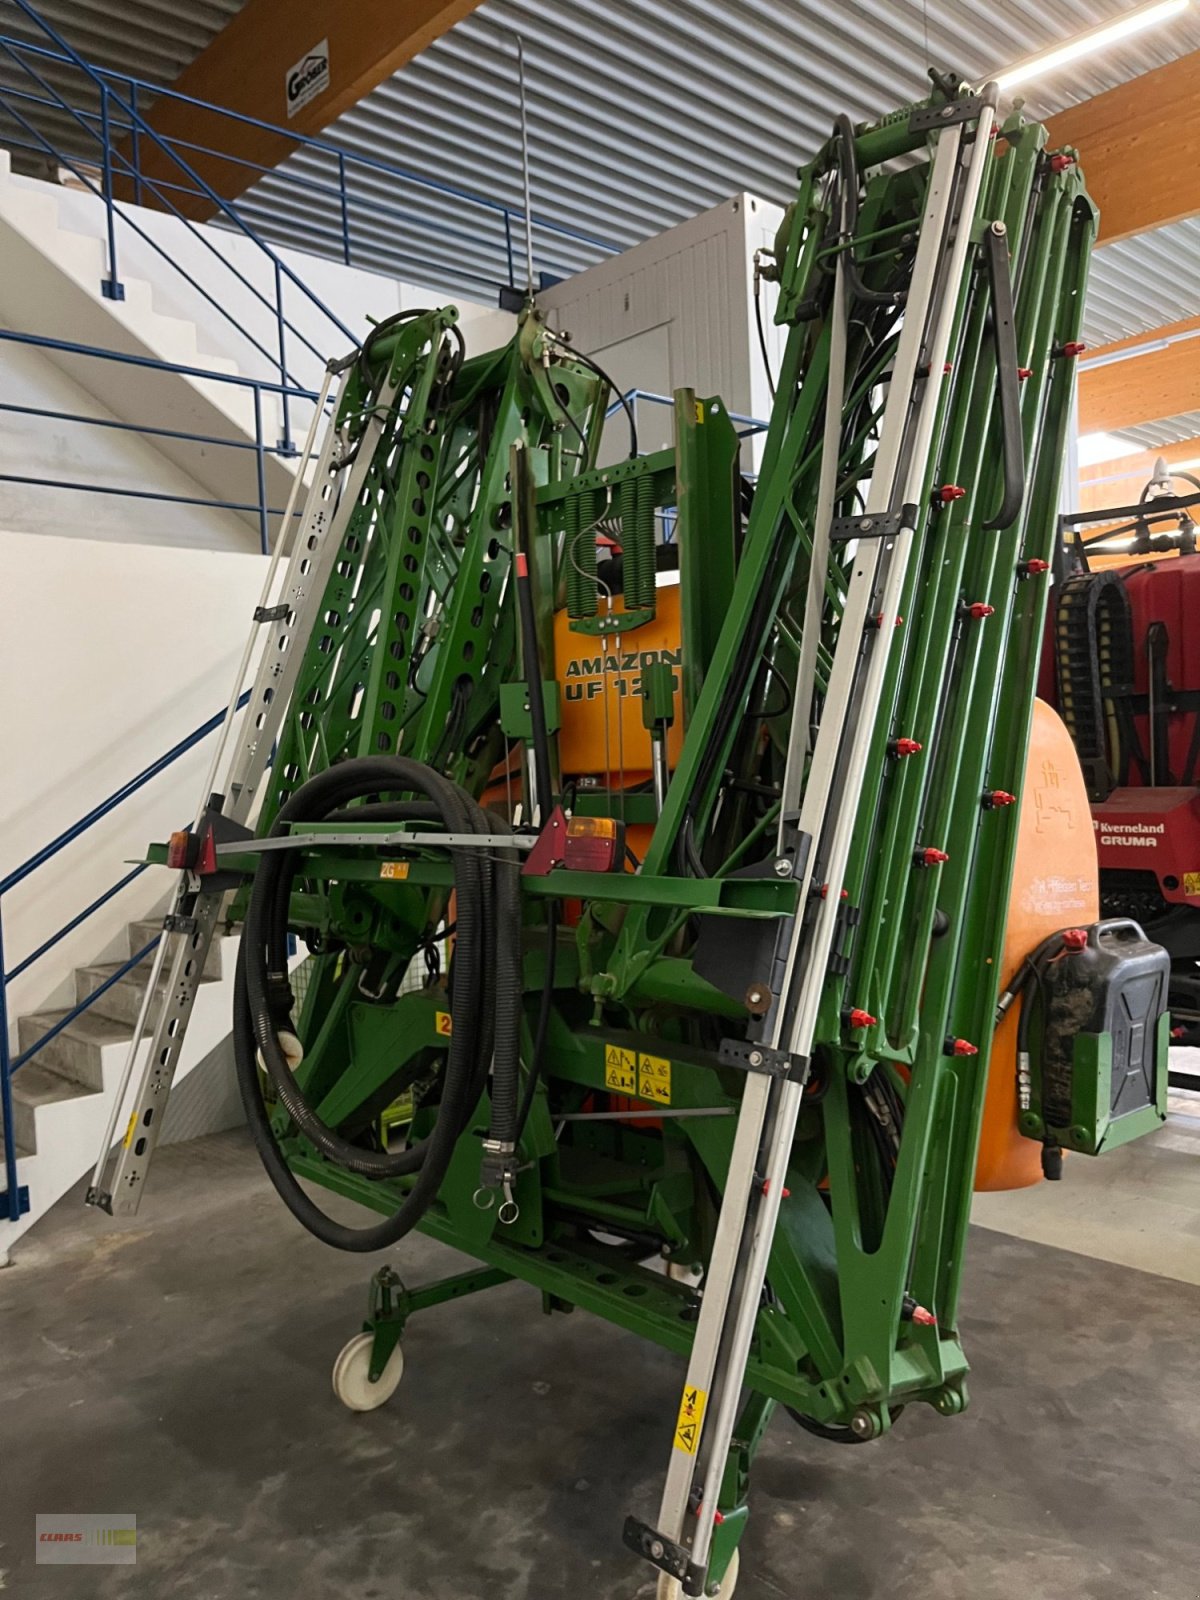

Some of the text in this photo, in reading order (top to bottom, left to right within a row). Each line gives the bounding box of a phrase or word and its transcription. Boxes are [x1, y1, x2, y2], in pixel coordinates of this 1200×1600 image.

[566, 675, 679, 701] UF 12
[1100, 822, 1165, 834] Kverneland
[1100, 836, 1157, 847] GRUMA
